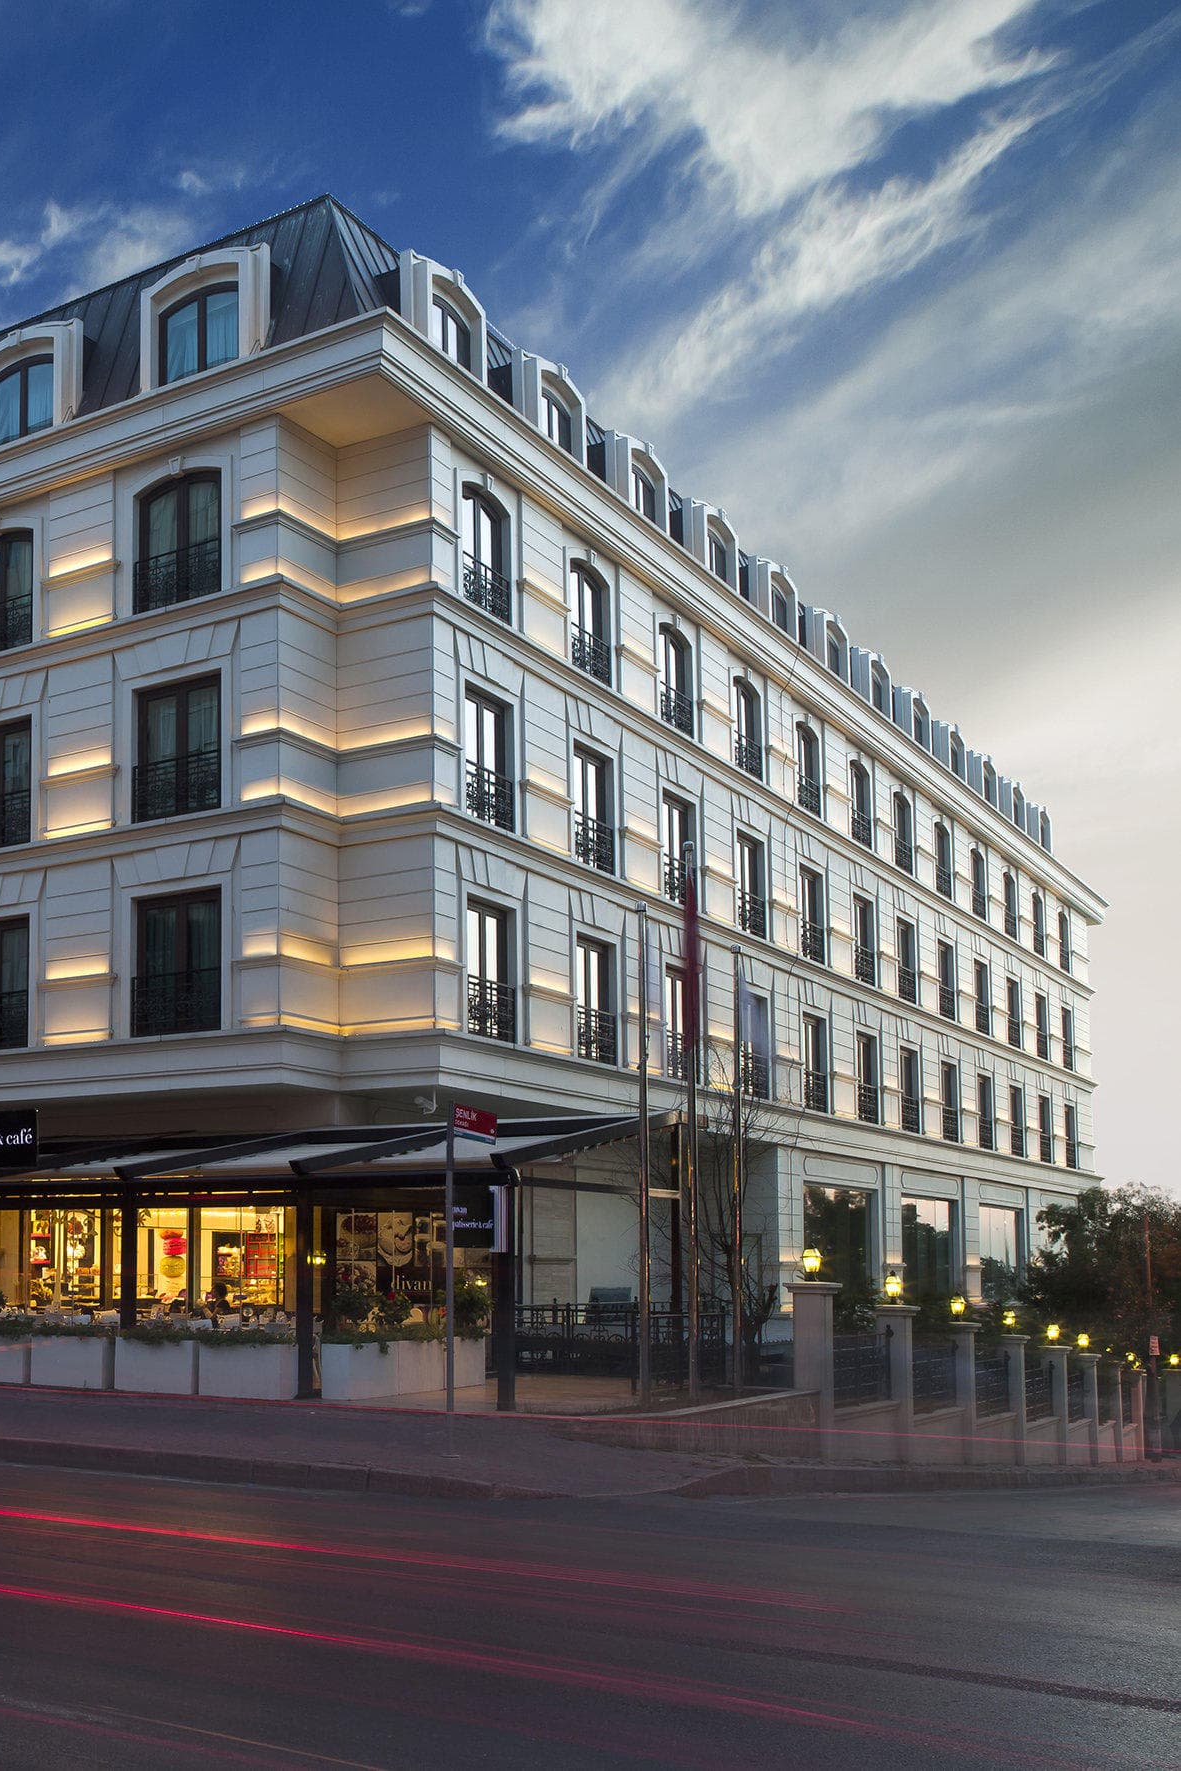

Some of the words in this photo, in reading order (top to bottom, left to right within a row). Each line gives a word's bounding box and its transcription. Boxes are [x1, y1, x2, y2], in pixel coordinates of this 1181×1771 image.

[455, 1107, 477, 1121] ŞENLİK
[6, 1127, 33, 1145] café
[390, 1274, 433, 1291] divan
